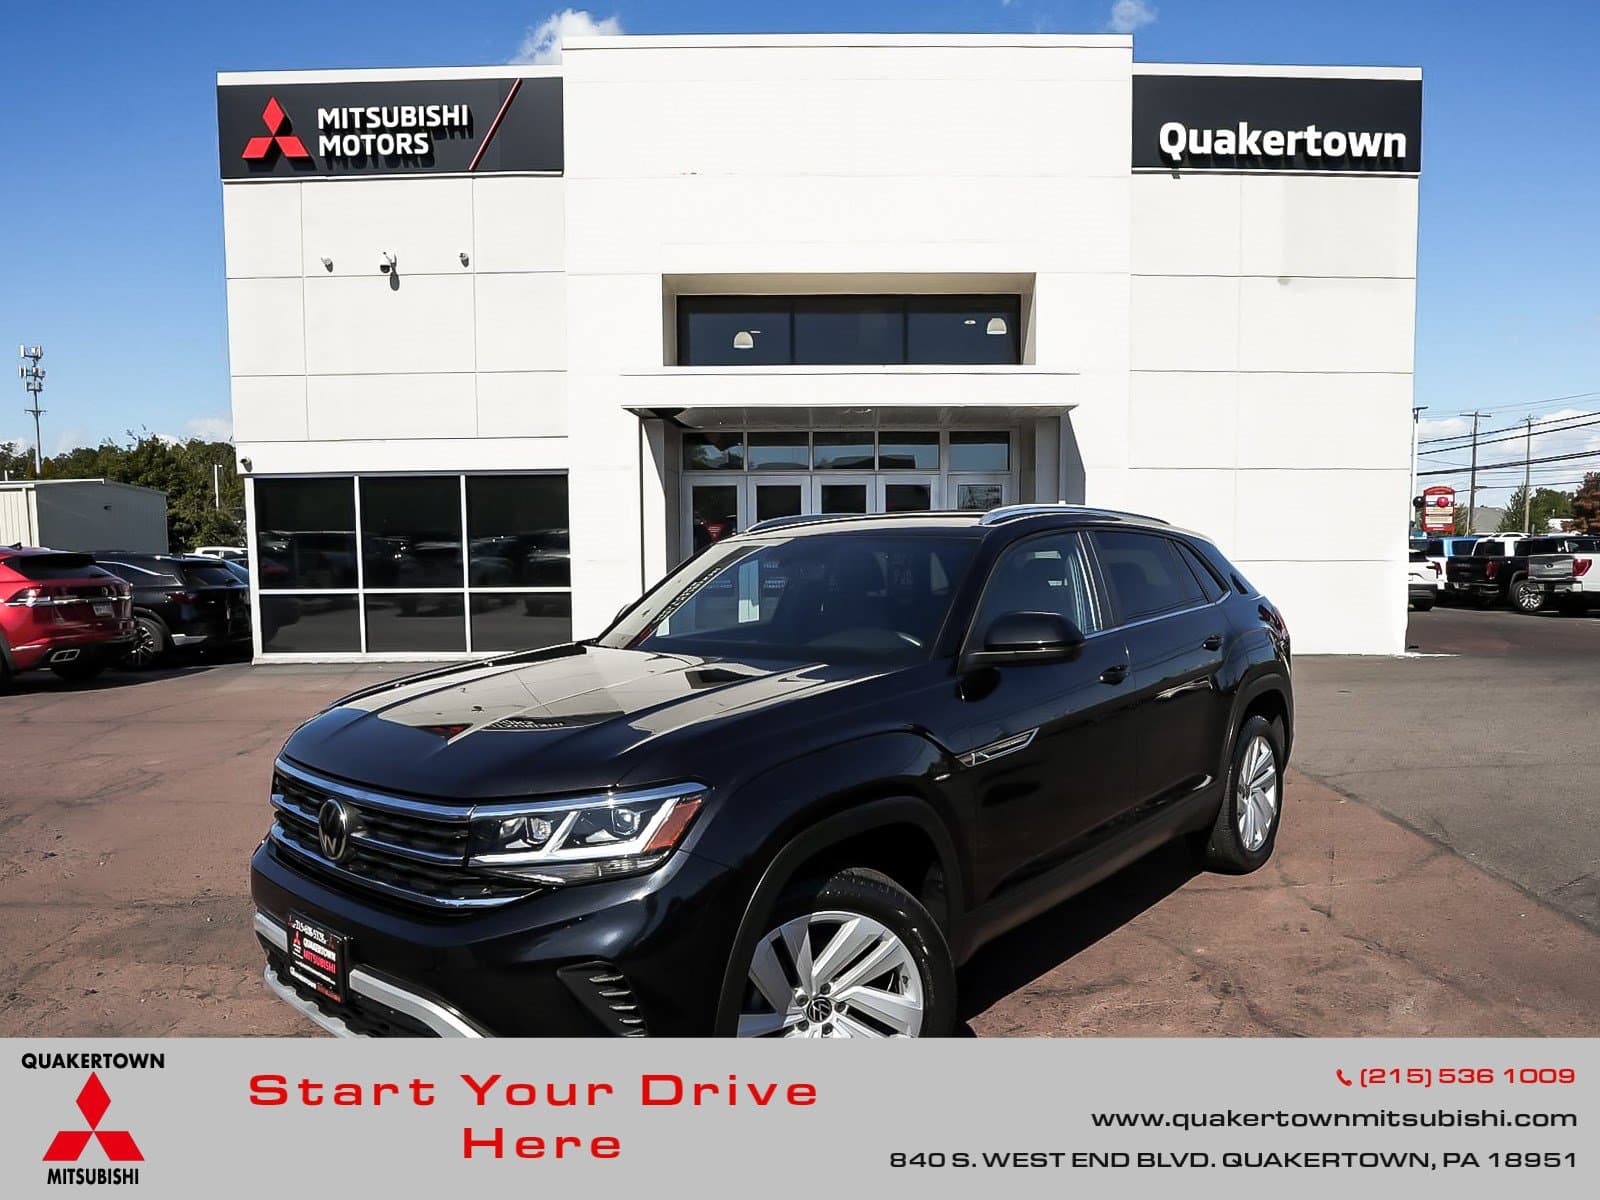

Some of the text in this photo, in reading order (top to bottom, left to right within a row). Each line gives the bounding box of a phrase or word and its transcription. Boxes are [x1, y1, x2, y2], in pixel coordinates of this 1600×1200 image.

[317, 104, 469, 130] MITSUBISHI
[319, 133, 429, 157] MOTORS
[1159, 121, 1407, 161] Quakertown
